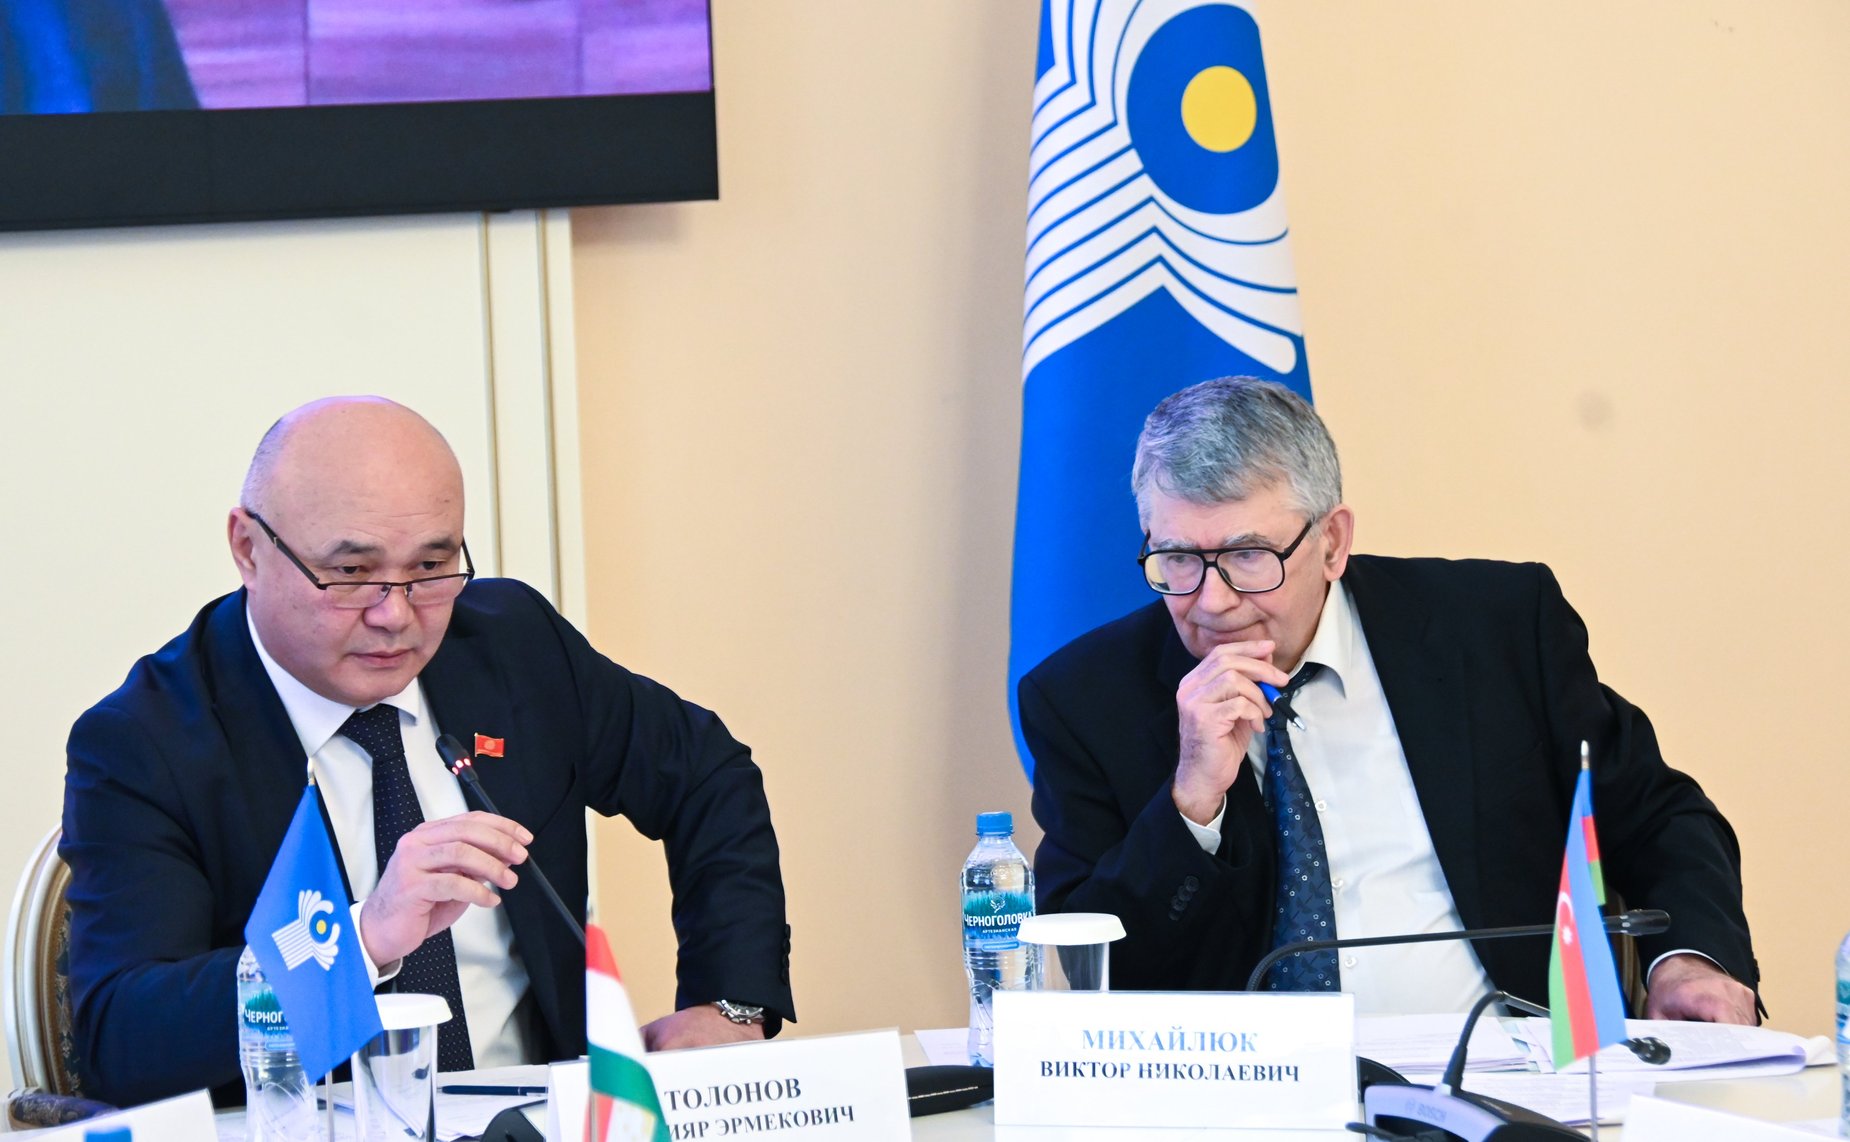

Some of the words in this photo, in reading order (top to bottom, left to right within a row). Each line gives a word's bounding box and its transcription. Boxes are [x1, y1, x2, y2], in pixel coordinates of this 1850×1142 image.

[244, 1009, 287, 1024] ЧЕРНОГ
[1082, 1025, 1258, 1053] МИХАЙЛЮК
[1040, 1060, 1131, 1079] ВИКТОР
[1138, 1062, 1300, 1082] НИКОЛАЕВИЧ
[664, 1077, 802, 1111] ТОЛОНОВ
[667, 1121, 709, 1141] ИЯР
[715, 1105, 855, 1136] ЭРМЕКОВИЧ
